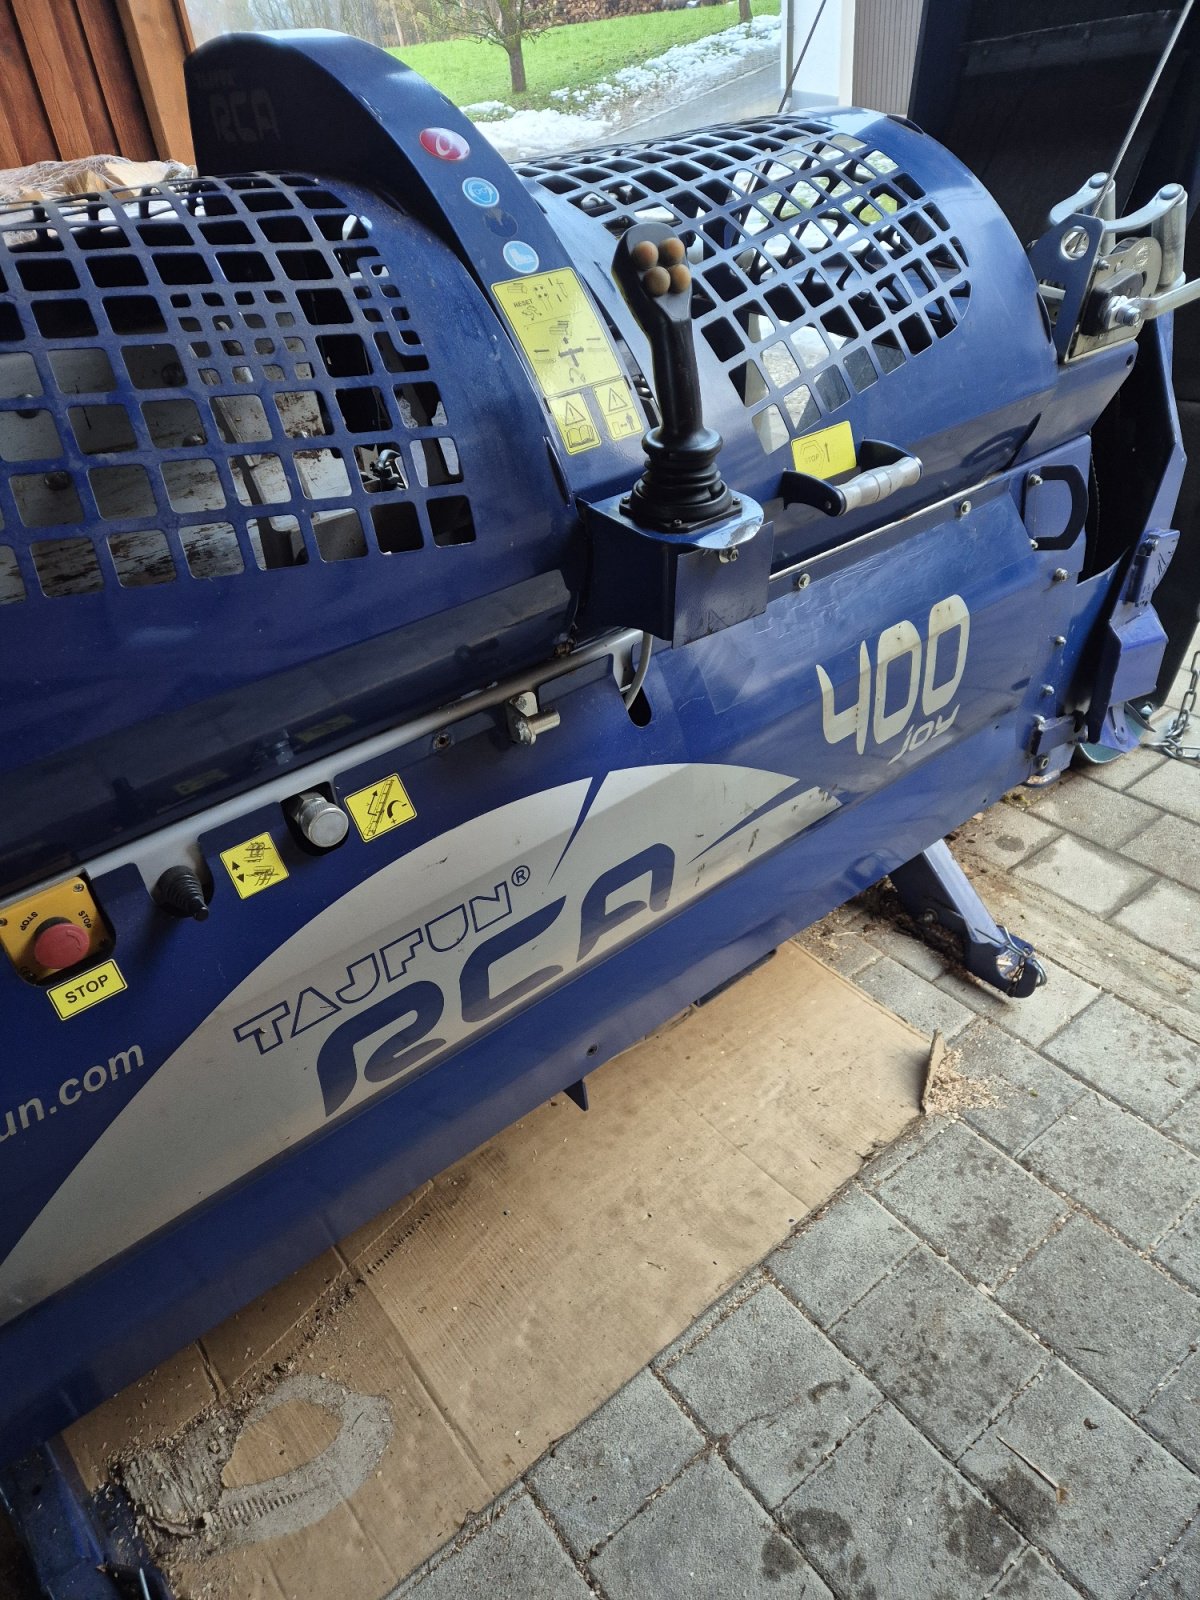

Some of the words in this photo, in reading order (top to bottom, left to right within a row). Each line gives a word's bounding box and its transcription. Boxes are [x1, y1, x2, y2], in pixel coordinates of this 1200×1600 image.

[815, 594, 971, 755] 400
[20, 911, 38, 931] STOP
[78, 910, 93, 929] STOP
[65, 974, 109, 1005] STOP
[316, 842, 675, 1117] RCA
